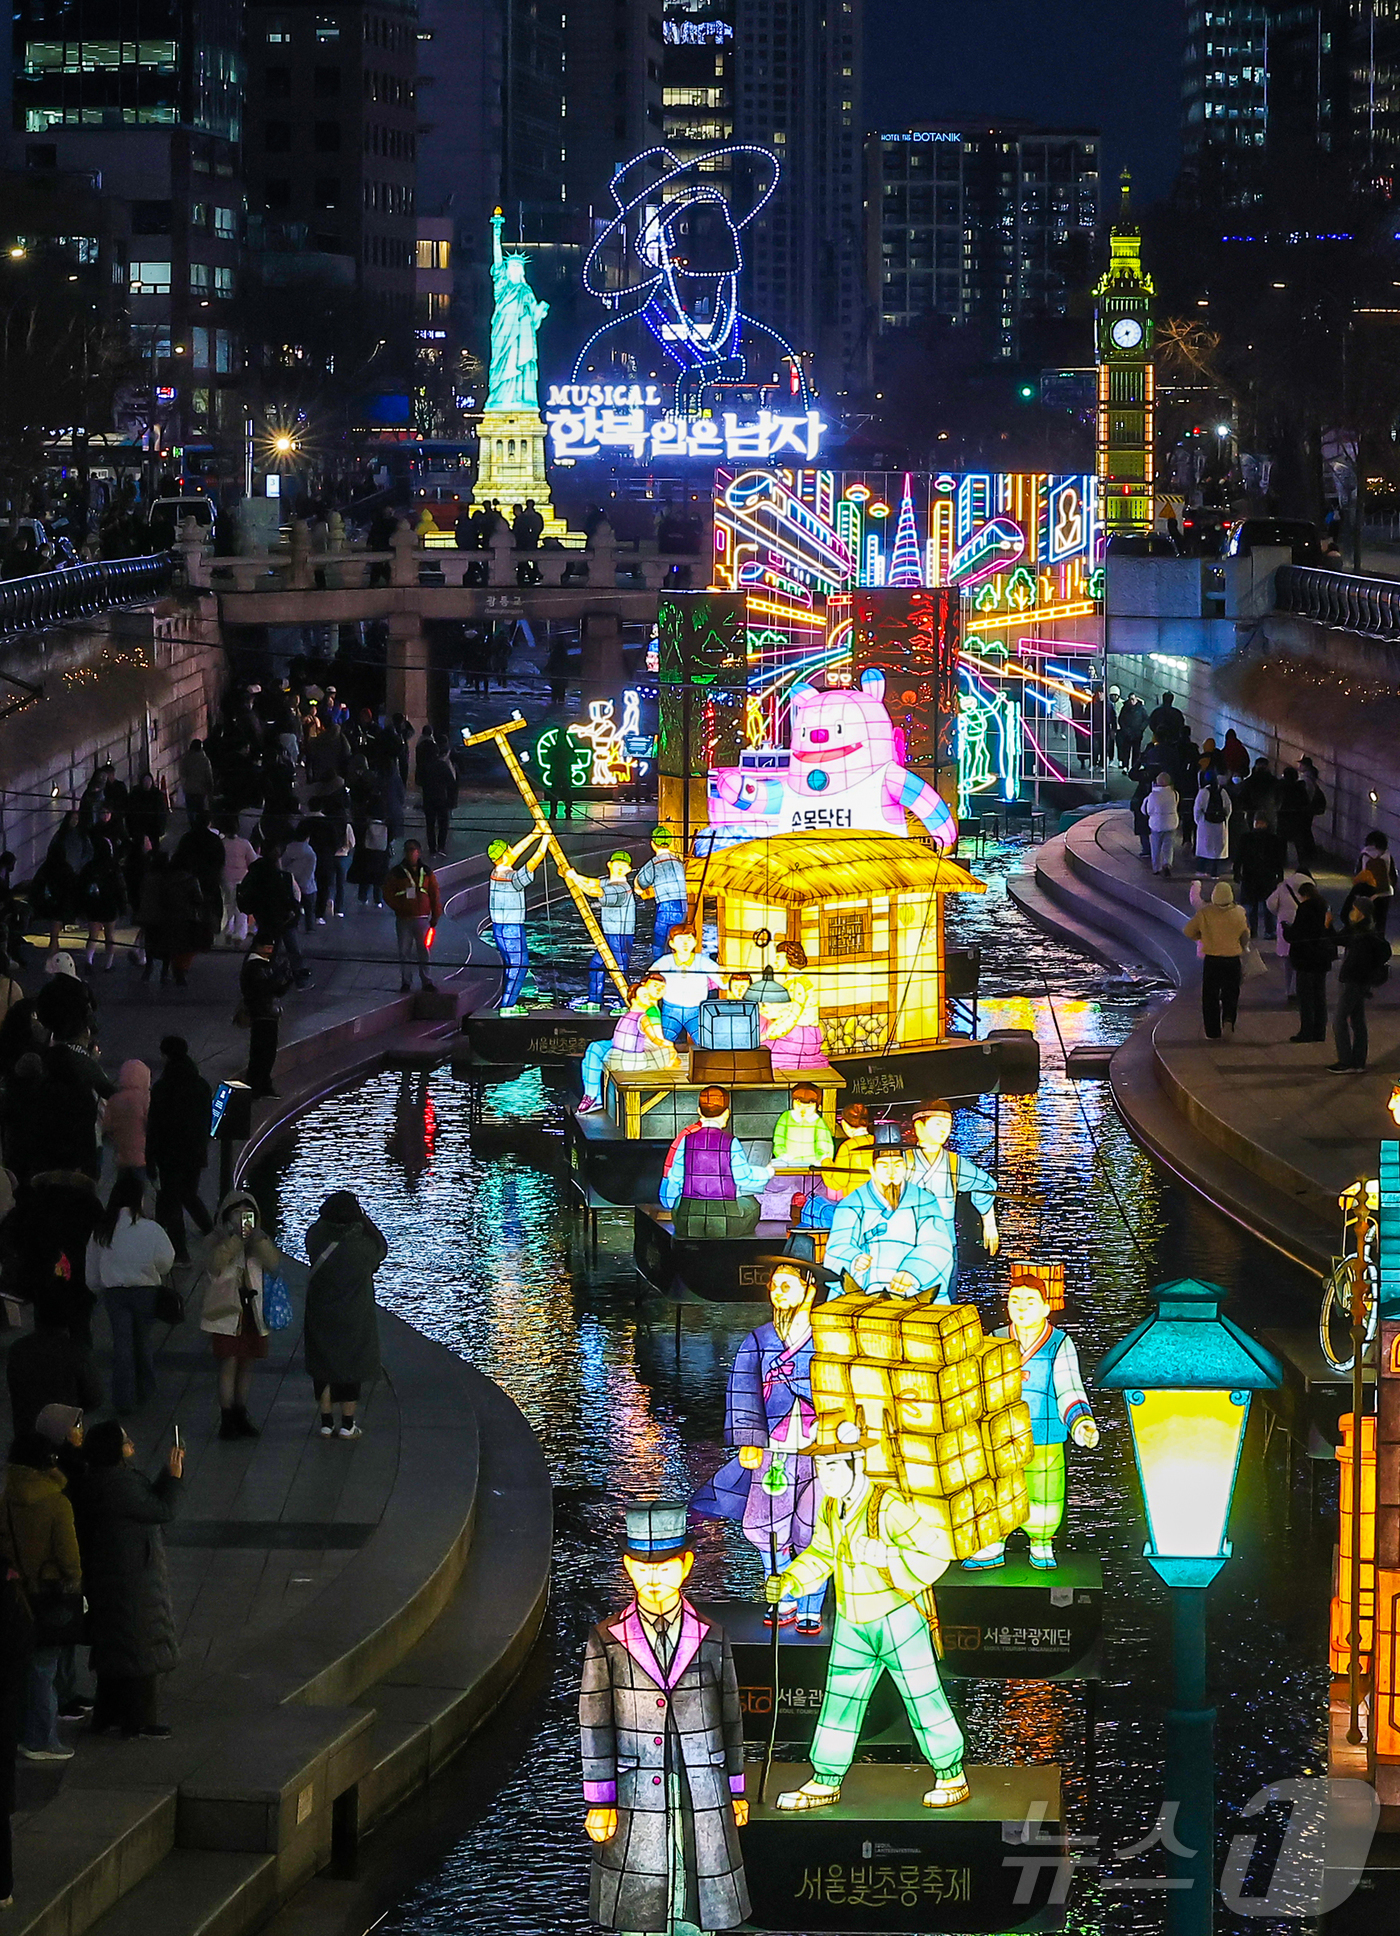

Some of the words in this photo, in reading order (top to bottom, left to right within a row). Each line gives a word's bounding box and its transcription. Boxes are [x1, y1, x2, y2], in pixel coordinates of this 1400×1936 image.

[913, 132, 961, 142] BOTANIK
[547, 385, 661, 406] MUSICAL
[546, 406, 650, 459] 한복
[722, 409, 828, 461] 남자
[527, 1036, 593, 1055] 서울빛초롱축
[984, 1626, 1072, 1646] 서울관광재단
[779, 1688, 823, 1707] 서울관
[794, 1863, 971, 1907] 서울빛초롱축제
